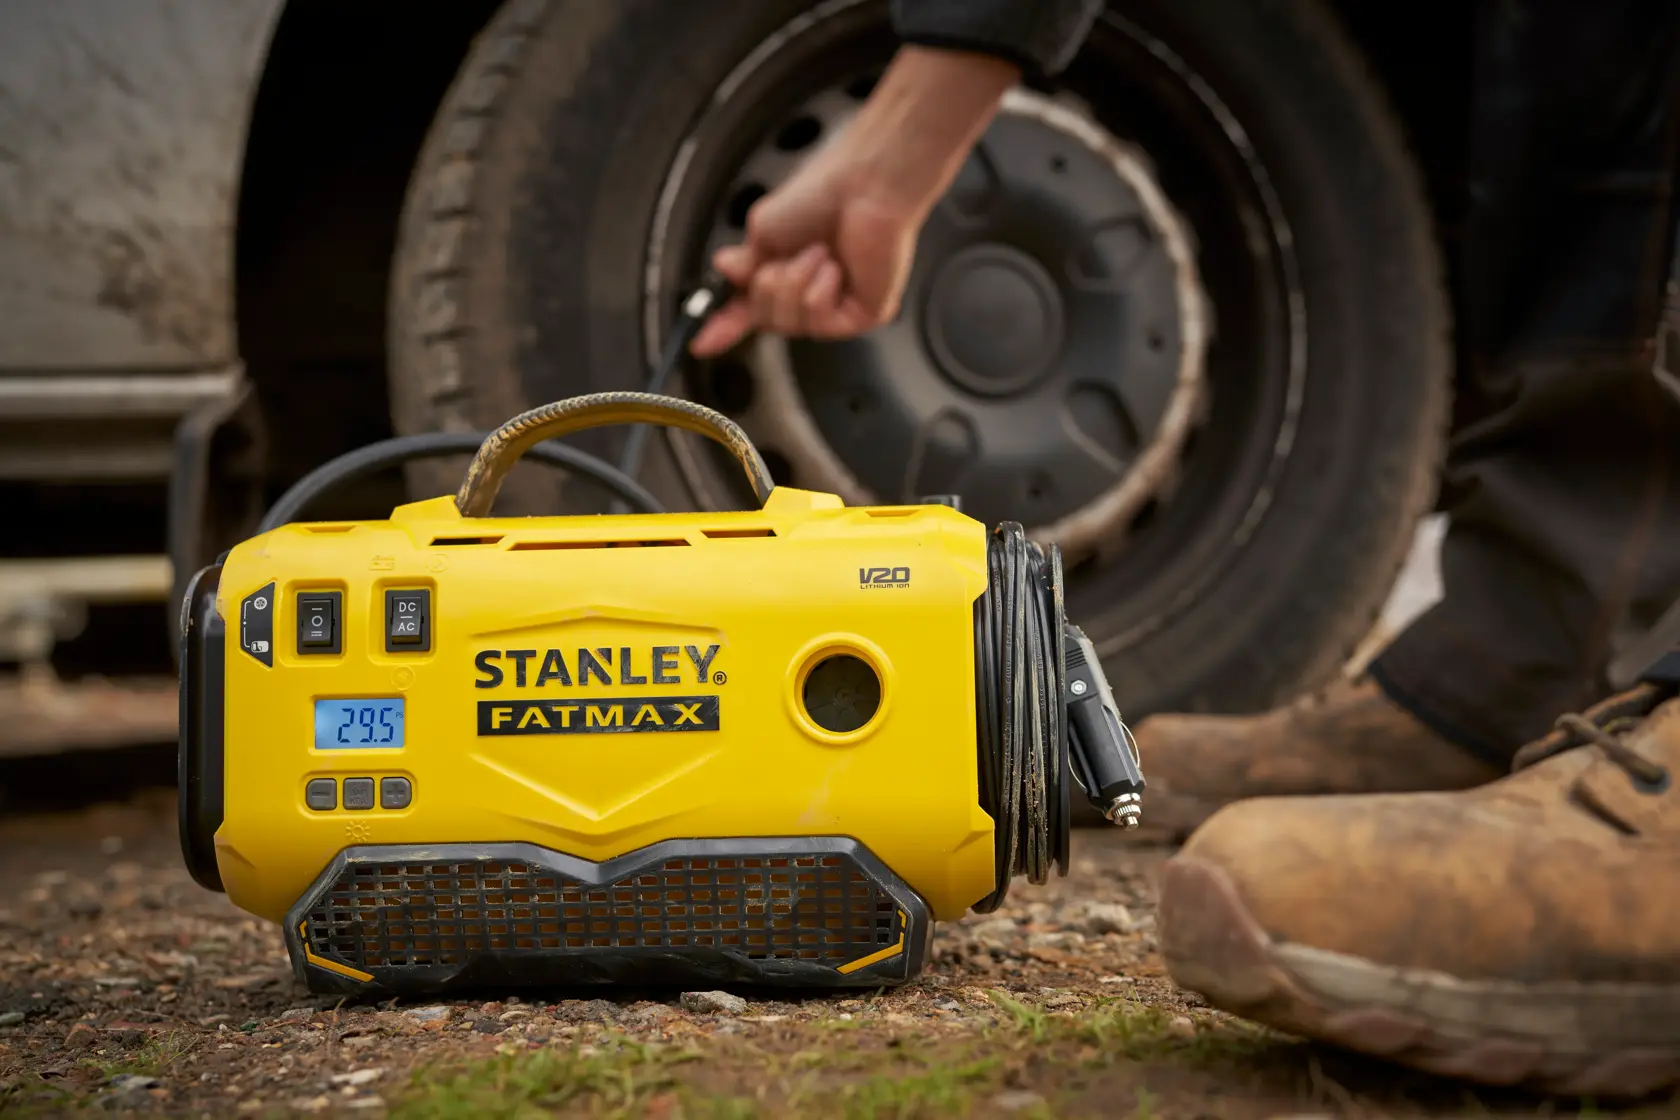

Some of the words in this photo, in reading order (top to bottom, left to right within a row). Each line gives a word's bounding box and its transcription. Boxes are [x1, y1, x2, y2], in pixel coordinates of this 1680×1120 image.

[859, 567, 910, 584] V20
[398, 601, 417, 613] DC
[397, 622, 415, 632] AC
[491, 702, 705, 730] FATMAX
[337, 707, 394, 743] 29.5
